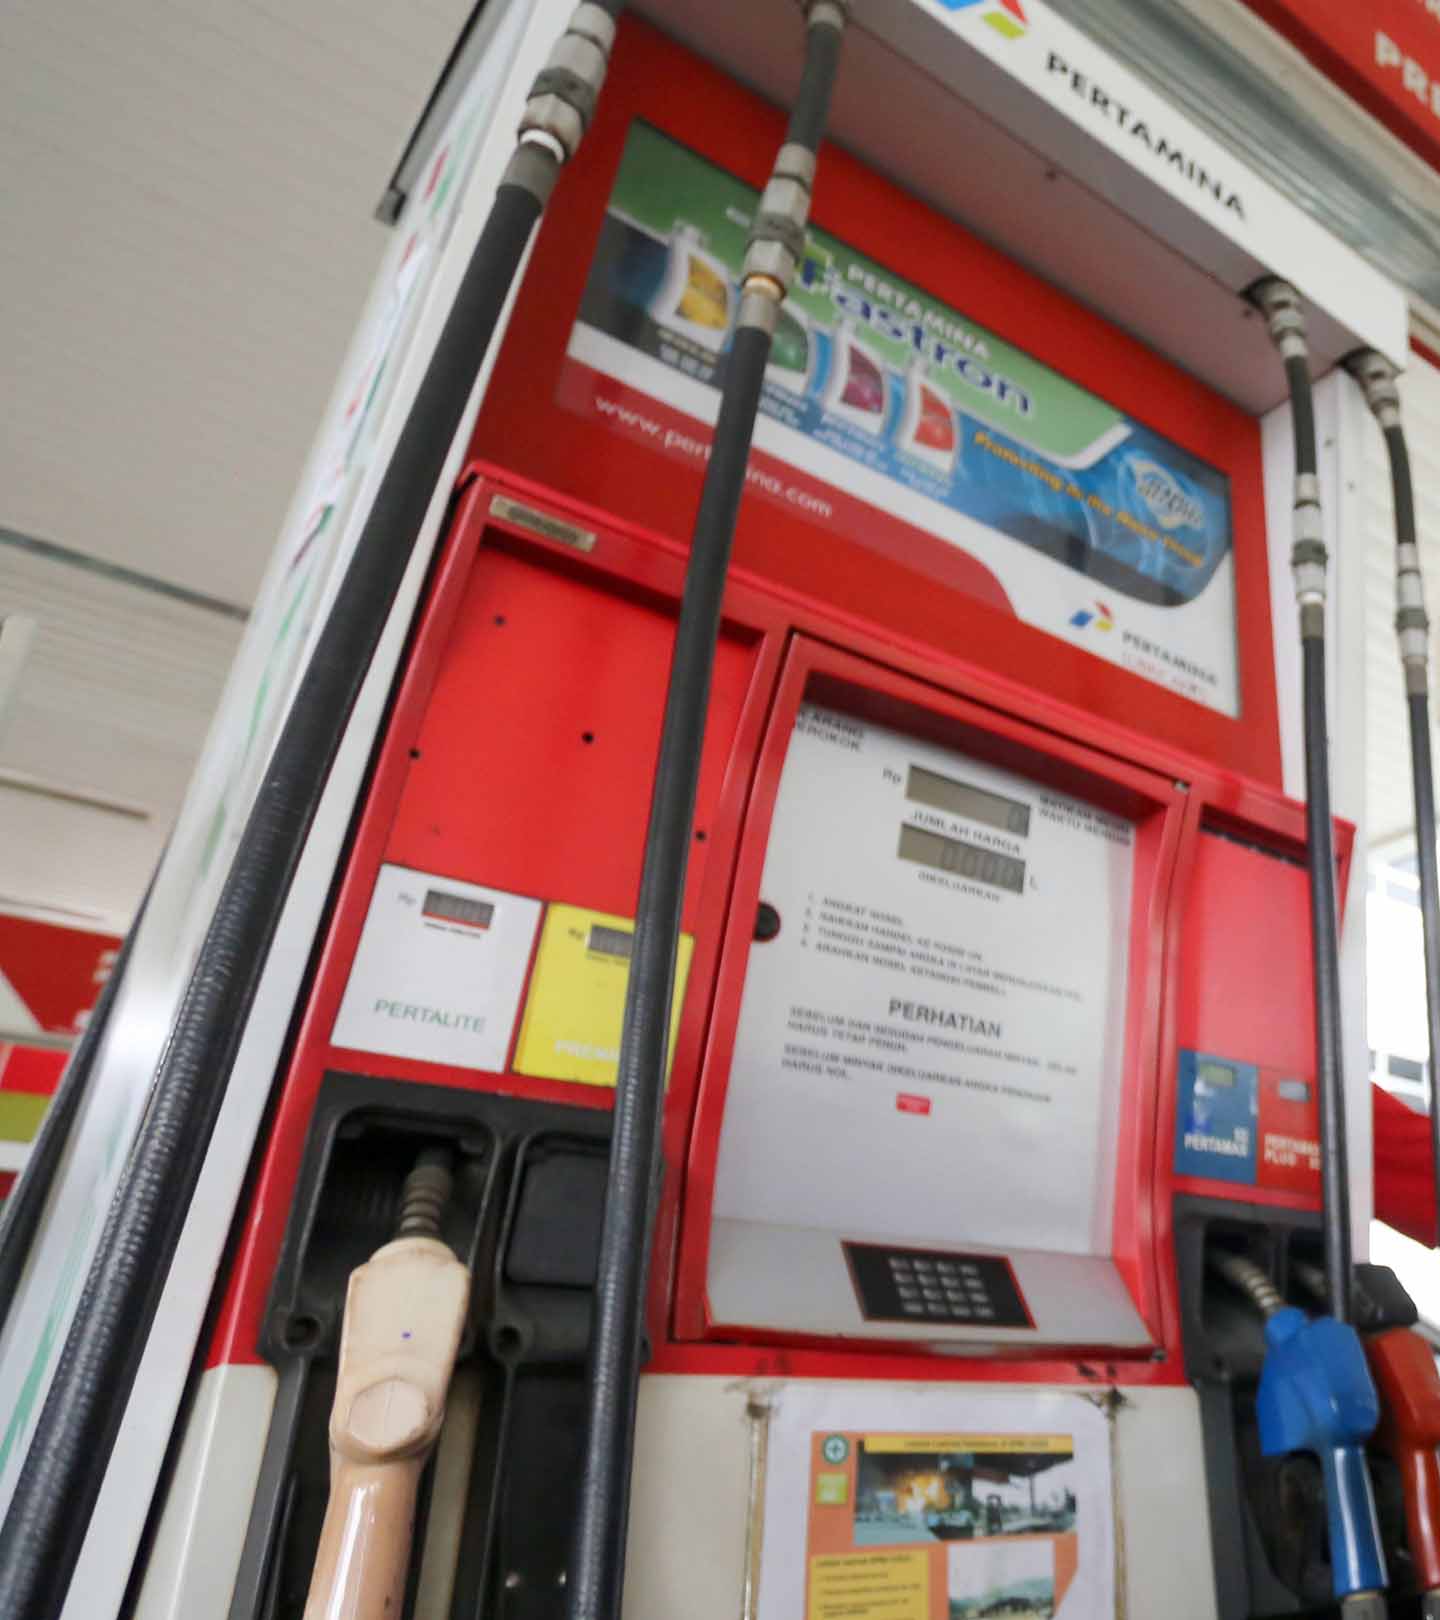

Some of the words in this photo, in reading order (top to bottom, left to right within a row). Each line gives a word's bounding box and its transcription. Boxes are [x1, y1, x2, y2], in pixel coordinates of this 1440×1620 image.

[1046, 50, 1246, 219] PERTAMINA
[848, 262, 991, 358] PERTAMINA
[1121, 631, 1218, 686] PERTAMINA
[374, 999, 486, 1034] PERTALITE
[888, 996, 1002, 1039] PERHATIAN
[1184, 1132, 1248, 1158] PERTAMAX
